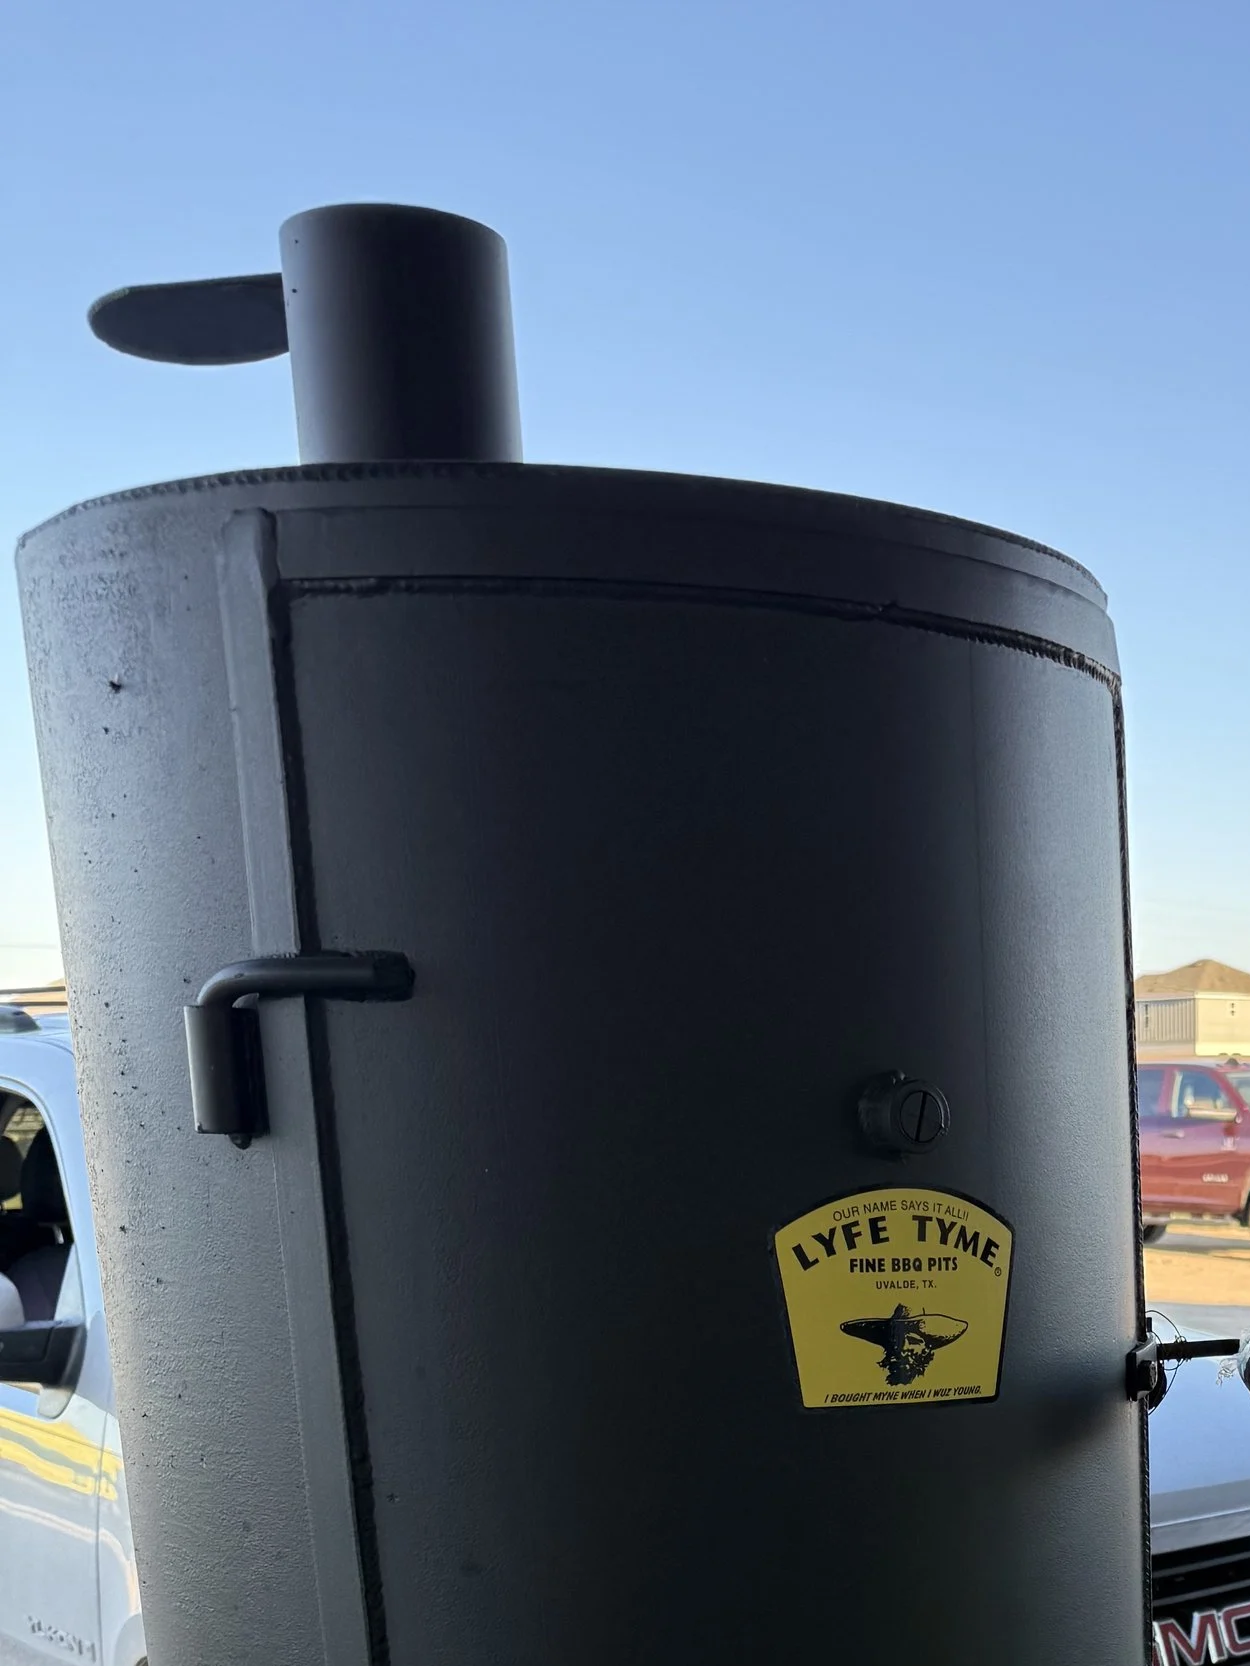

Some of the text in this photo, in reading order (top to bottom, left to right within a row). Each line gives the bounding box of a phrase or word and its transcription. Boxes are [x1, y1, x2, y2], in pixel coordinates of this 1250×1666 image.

[833, 1206, 861, 1222] OUR
[863, 1200, 897, 1214] NAME
[900, 1200, 929, 1212] SAYS
[932, 1203, 943, 1213] IT
[791, 1215, 1000, 1271] LYFE TYME
[850, 1256, 958, 1273] FINE BBQ PITS
[876, 1279, 937, 1290] UVALDE, TX.
[831, 1392, 872, 1403] BOUGHT
[872, 1390, 900, 1401] MYNE
[901, 1389, 926, 1400] WHEN
[933, 1387, 951, 1397] WUZ
[953, 1385, 982, 1396] YOUNG.
